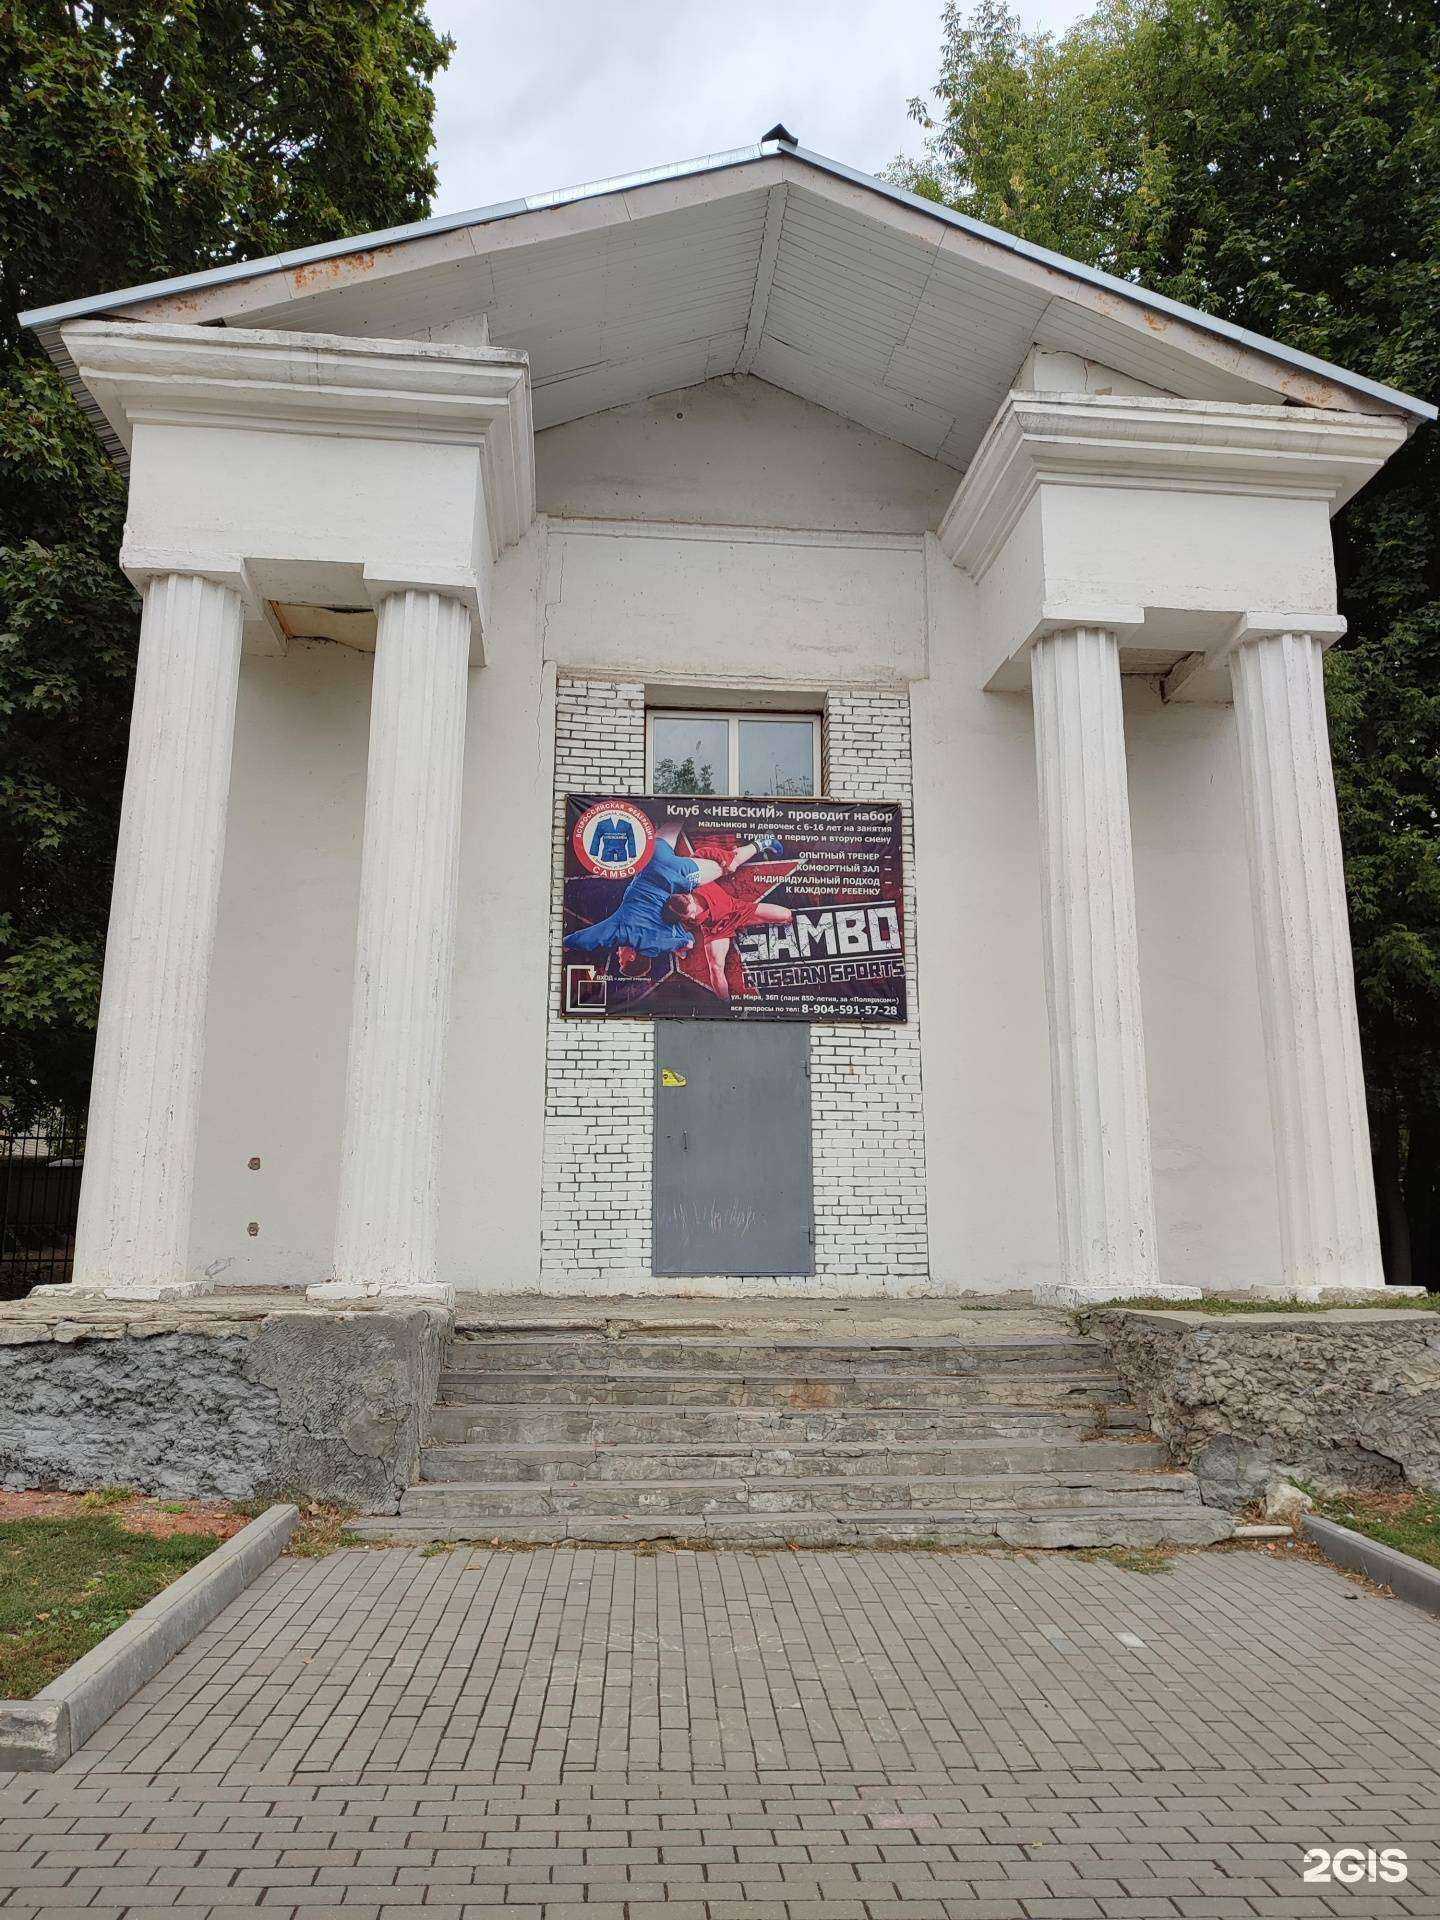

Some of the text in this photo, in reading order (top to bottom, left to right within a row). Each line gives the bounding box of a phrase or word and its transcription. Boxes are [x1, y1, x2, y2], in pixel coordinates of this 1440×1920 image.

[666, 804, 893, 824] Клуб «НЕВСКИЙ» проводит набор
[698, 821, 893, 834] мальчиков и девочек с 6-16 лет на занятия
[743, 833, 776, 842] группе
[784, 834, 819, 844] первую
[821, 834, 828, 842] и
[829, 834, 864, 844] вторую
[864, 835, 892, 845] смену
[799, 850, 880, 861] ОПЫТНЫЙ ТРЕНЕР
[592, 866, 636, 879] САМБО
[796, 863, 880, 873] КОМФОРТНЫЙ ЗАЛ
[753, 874, 881, 887] ИНДИВИДУАЛЬНЫЙ ПОДХОД
[785, 885, 881, 896] К КАЖДОМУ РЕБЕНКУ
[737, 906, 902, 962] SAMBO
[742, 957, 906, 989] RUSSIAN SPORTS
[801, 1003, 898, 1015] 8-904-591-57-28
